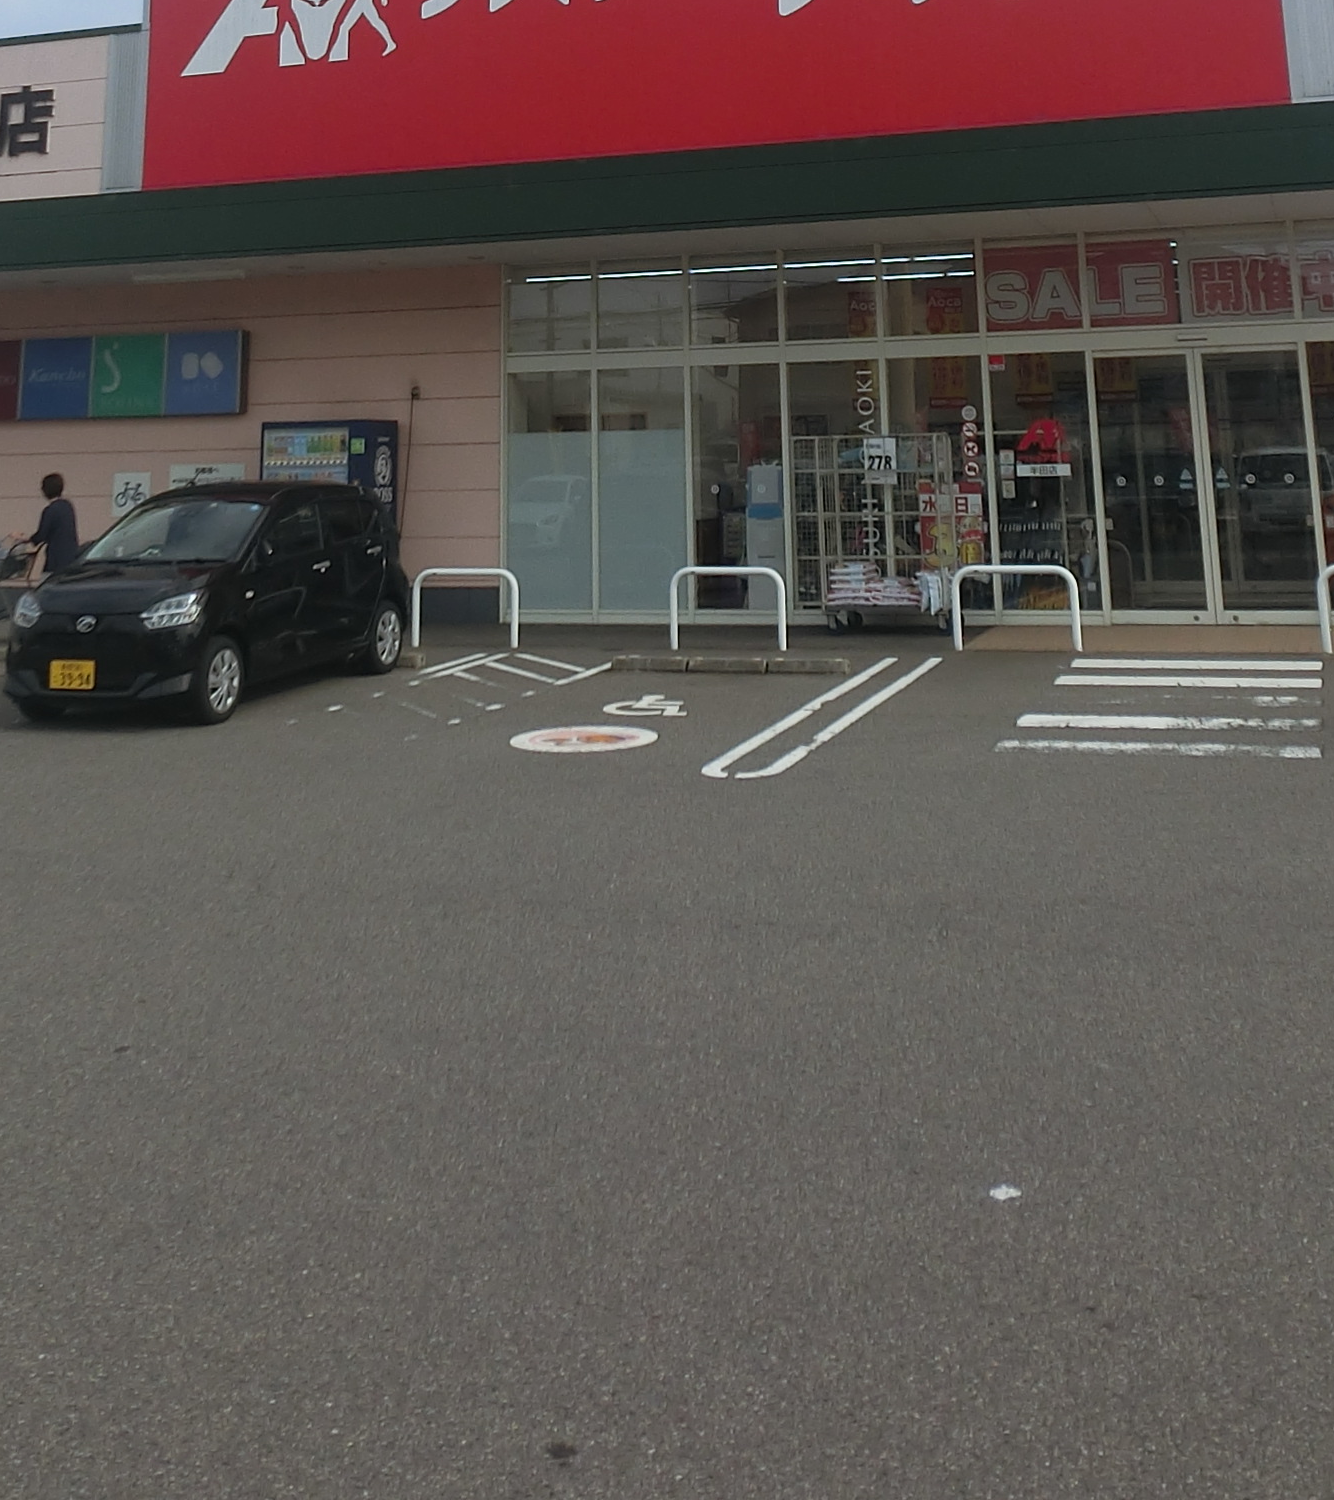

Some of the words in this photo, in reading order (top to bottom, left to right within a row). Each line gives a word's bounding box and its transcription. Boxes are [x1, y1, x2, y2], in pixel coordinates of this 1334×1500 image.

[984, 263, 1167, 323] SALE
[850, 300, 877, 311] Aoc
[868, 455, 893, 471] 278
